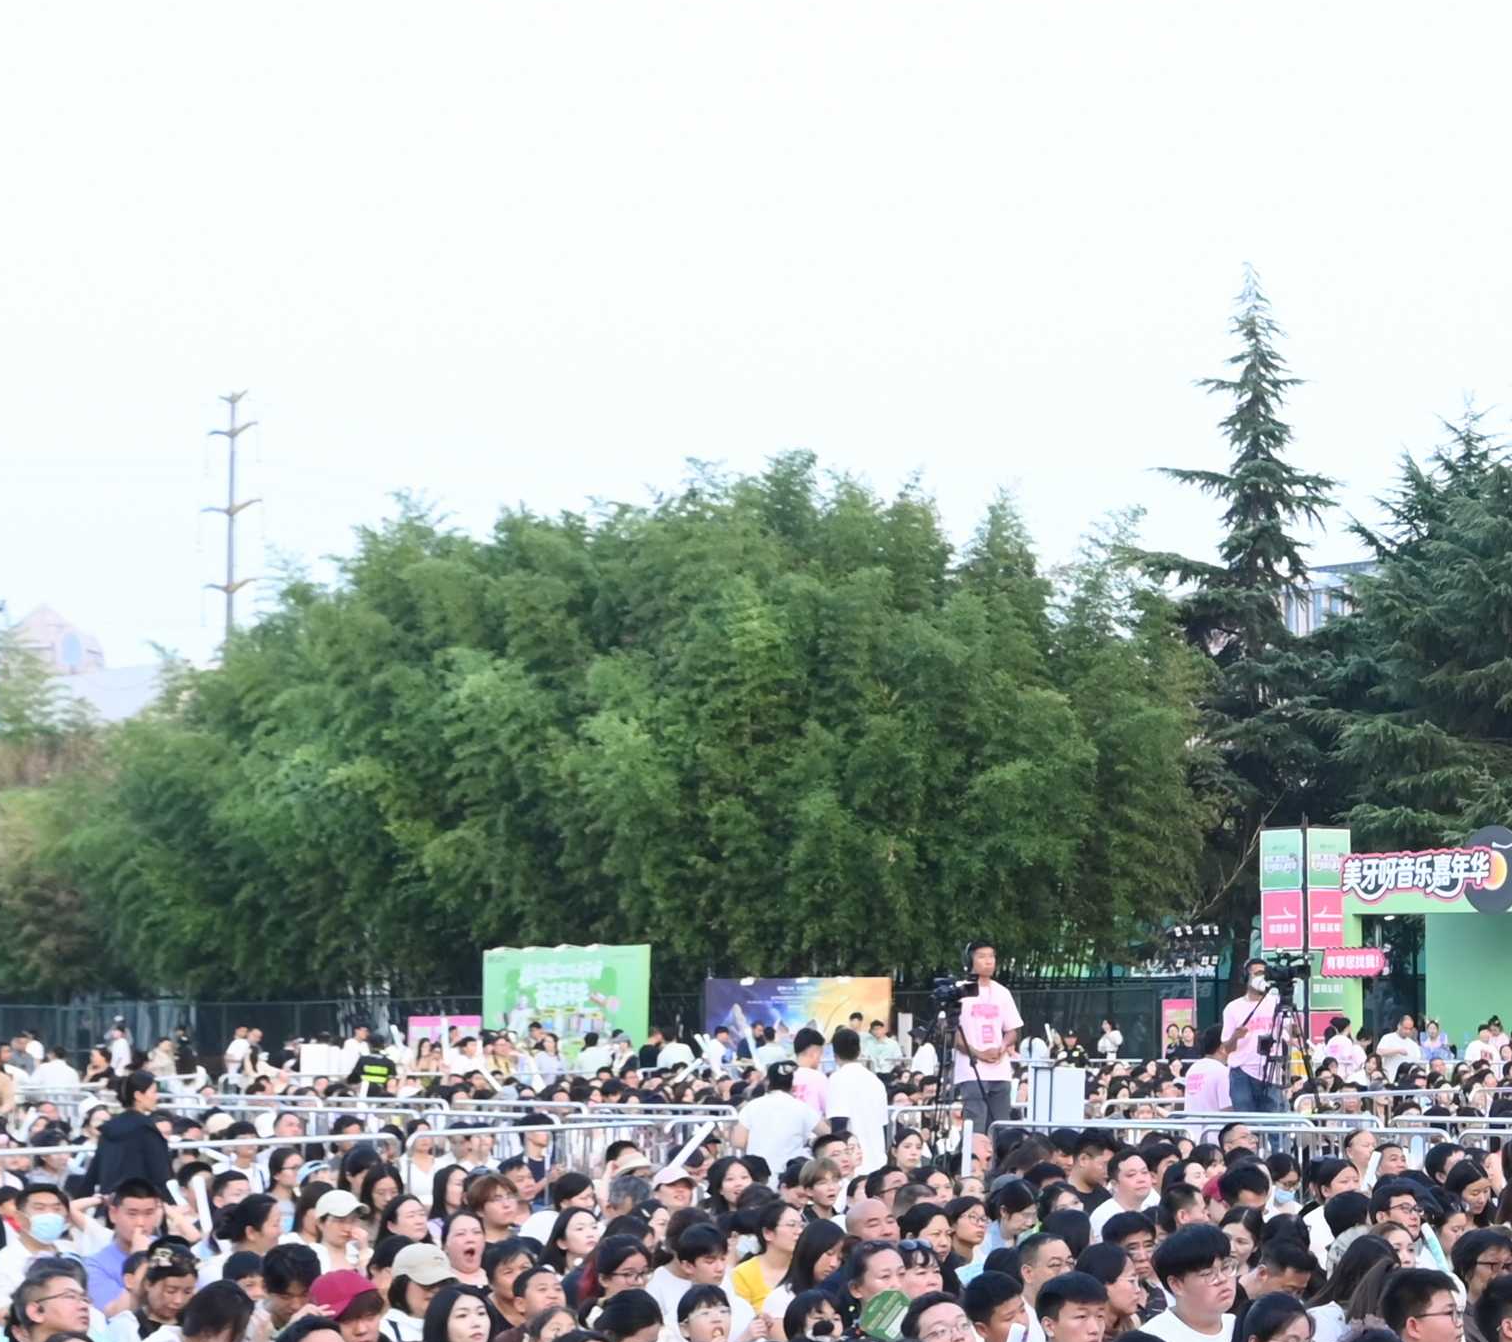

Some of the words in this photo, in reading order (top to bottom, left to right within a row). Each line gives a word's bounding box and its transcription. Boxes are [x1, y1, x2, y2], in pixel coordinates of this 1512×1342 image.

[1342, 851, 1491, 902] 美牙呀音乐嘉年华
